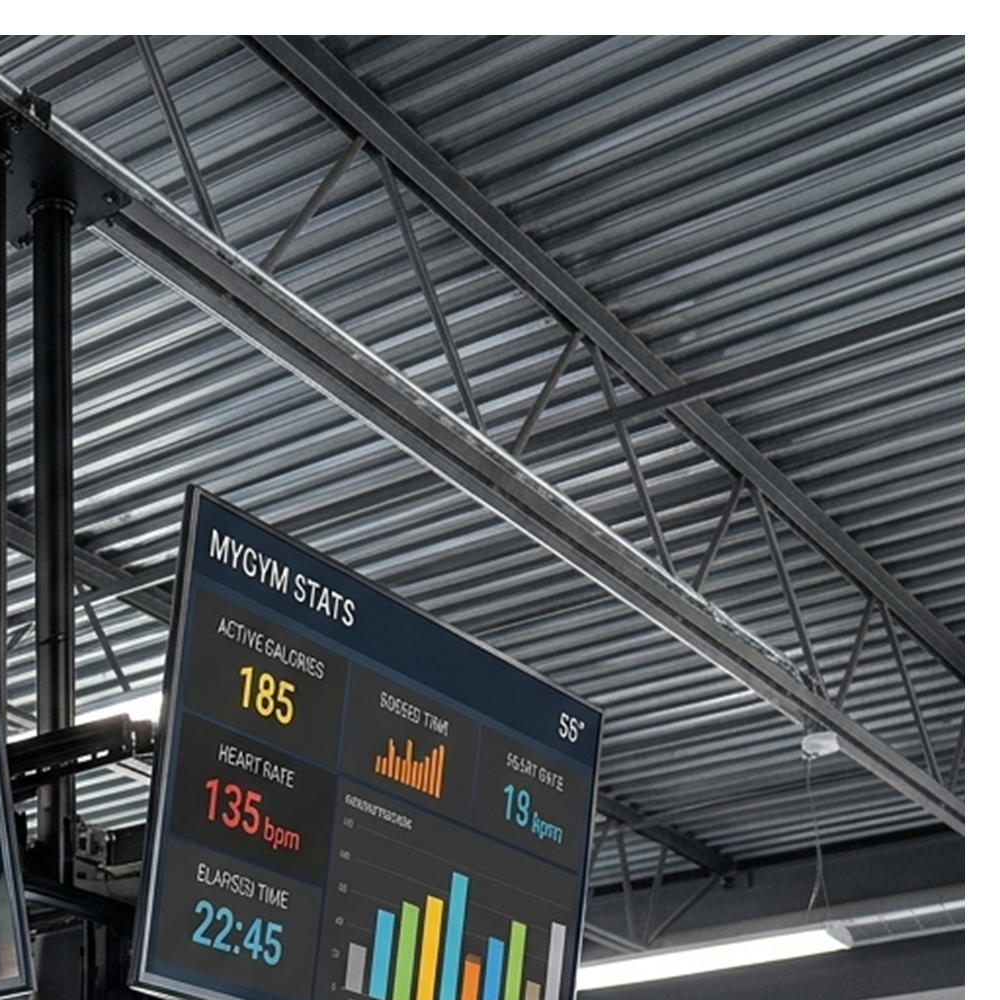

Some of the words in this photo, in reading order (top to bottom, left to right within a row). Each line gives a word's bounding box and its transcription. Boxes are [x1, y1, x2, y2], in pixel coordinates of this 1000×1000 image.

[209, 528, 290, 595] MYGYM
[293, 573, 356, 627] STATS
[217, 617, 264, 653] ACTIVE
[240, 666, 295, 725] 185
[218, 743, 263, 775] HEART
[262, 761, 296, 789] RATE
[206, 779, 262, 835] 135
[263, 816, 300, 851] bpm
[257, 881, 290, 910] TIME
[191, 899, 284, 966] 22:45
